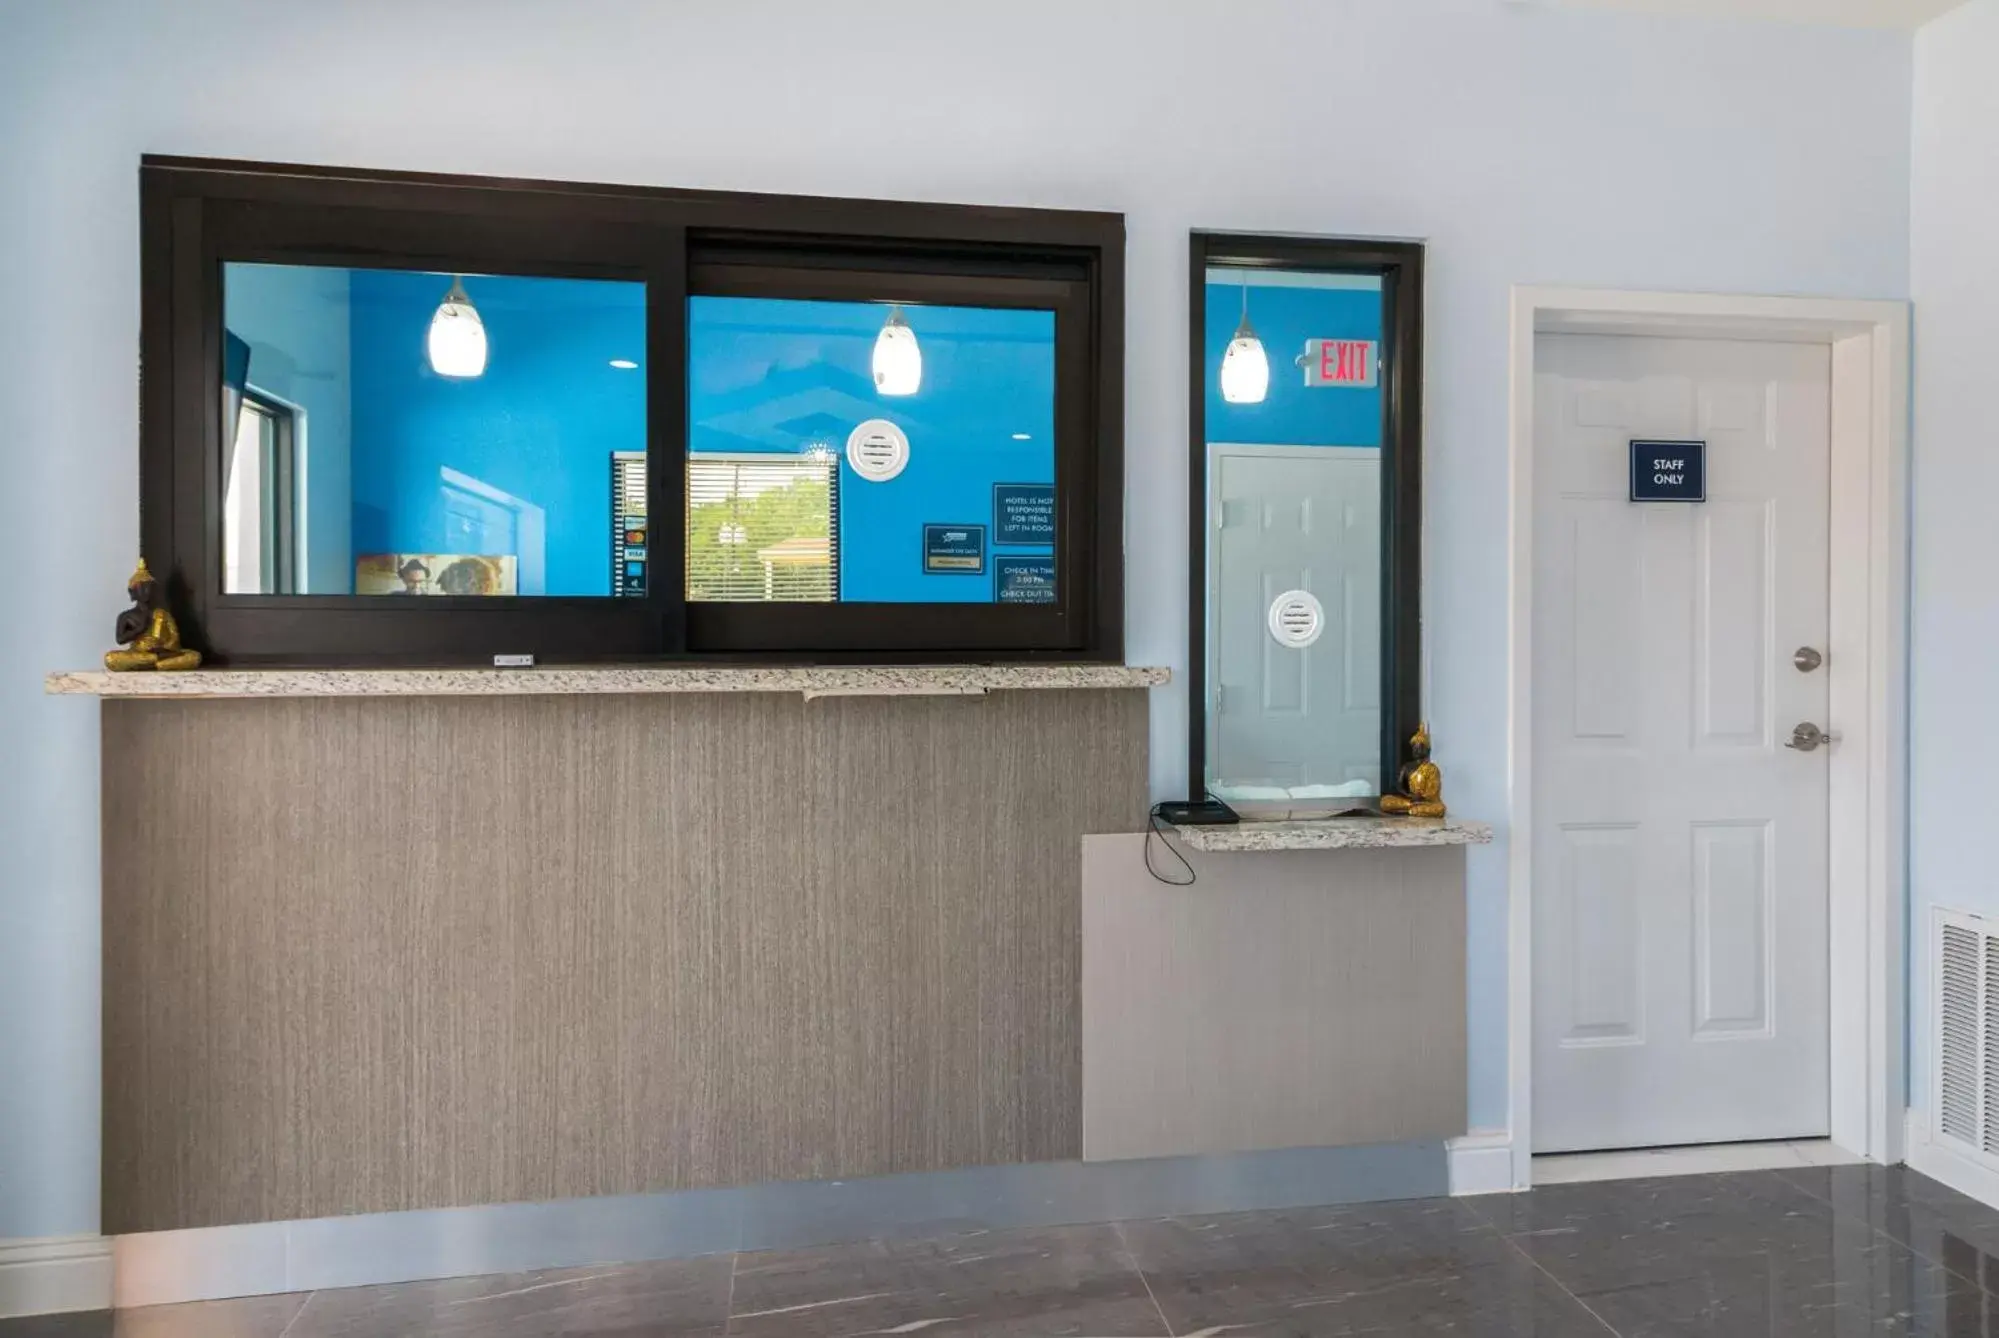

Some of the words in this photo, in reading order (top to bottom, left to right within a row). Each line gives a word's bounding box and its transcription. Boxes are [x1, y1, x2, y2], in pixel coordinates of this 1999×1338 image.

[1321, 341, 1370, 382] EXIT
[1653, 459, 1685, 470] STAFF
[1653, 473, 1685, 485] ONLY
